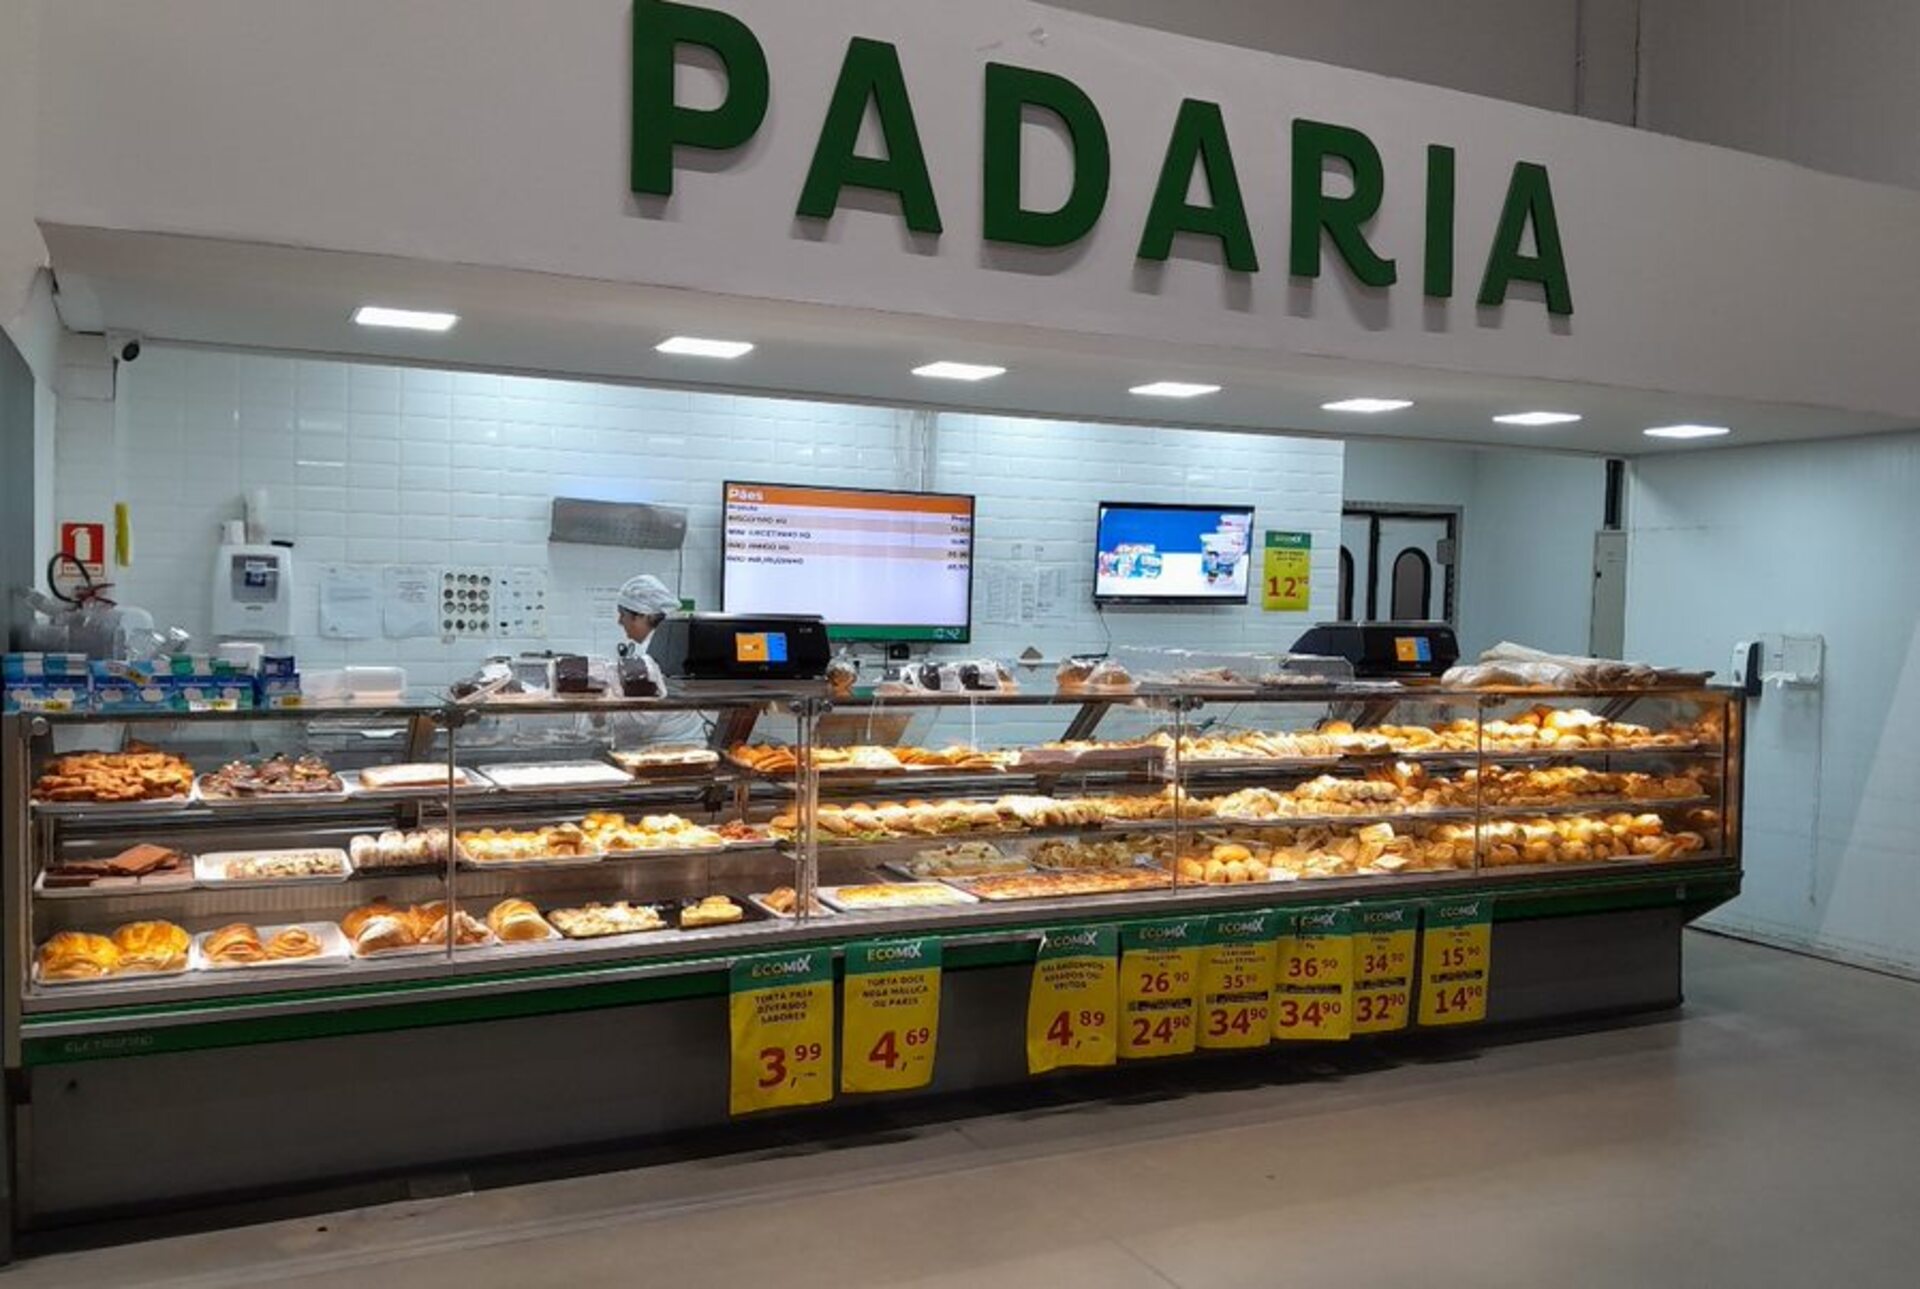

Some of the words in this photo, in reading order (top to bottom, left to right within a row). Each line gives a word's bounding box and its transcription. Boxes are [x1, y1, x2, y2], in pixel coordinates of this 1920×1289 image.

[631, 0, 1573, 316] PADARIA
[1140, 922, 1188, 940] ECOMIX
[1218, 916, 1265, 934] ECOMIX
[867, 941, 922, 962] ECOMIX
[752, 954, 811, 977] ECOMIX
[754, 991, 786, 1004] TORTA
